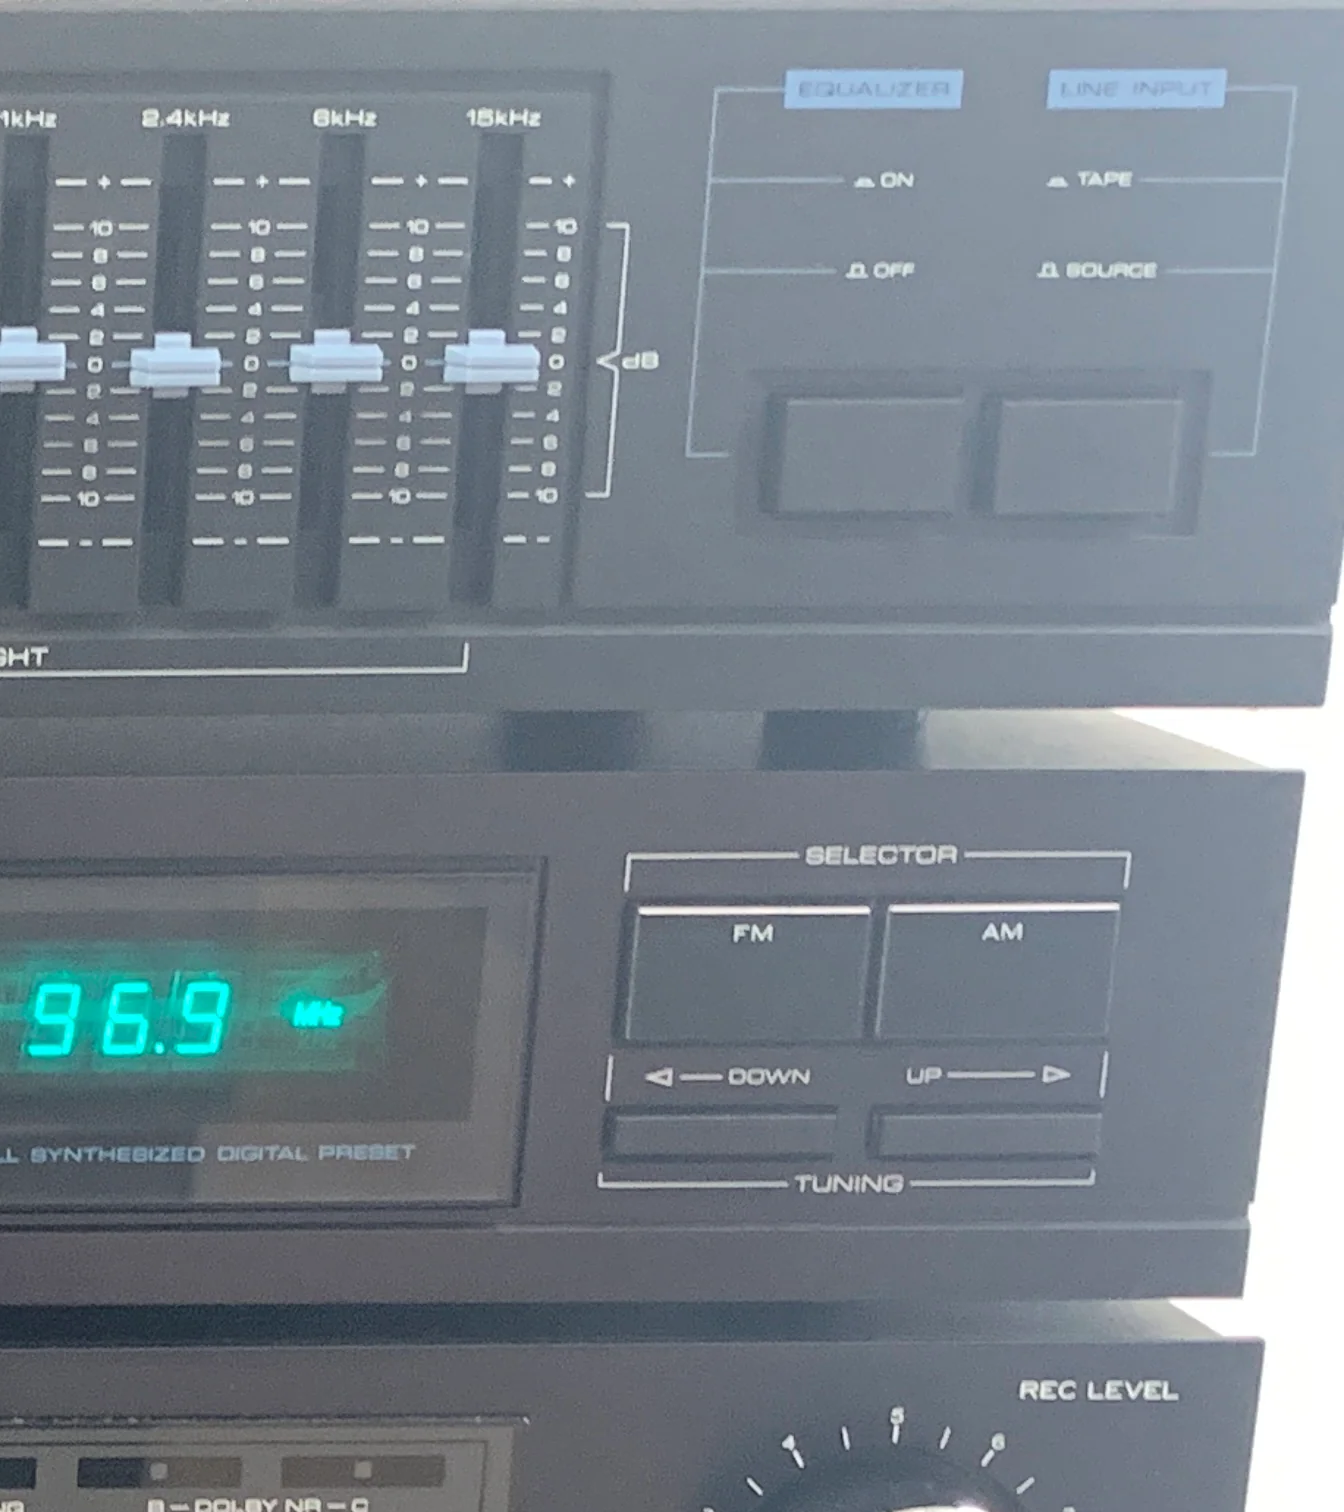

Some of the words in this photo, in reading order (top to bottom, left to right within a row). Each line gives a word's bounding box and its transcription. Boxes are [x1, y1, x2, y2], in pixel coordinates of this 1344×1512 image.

[799, 80, 950, 98] EQUALIZER
[1061, 80, 1119, 98] LINE
[1132, 81, 1212, 97] INPUT
[0, 110, 56, 128] 1kHz
[142, 109, 230, 127] 2.4kHz
[314, 109, 377, 127] 6kHz
[467, 108, 541, 127] 15kHz
[881, 172, 914, 188] ON
[1078, 171, 1132, 187] TAPE
[873, 262, 914, 279] OFF
[1067, 262, 1157, 278] SOURCE
[806, 845, 957, 865] SELECTOR
[734, 924, 773, 942] FM
[982, 923, 1023, 940] AM
[25, 980, 232, 1059] 96.9
[293, 1000, 347, 1029] MHz
[728, 1068, 810, 1085] DOWN
[907, 1067, 942, 1084] UP
[31, 1146, 206, 1163] SYNTHESIZED
[217, 1144, 308, 1166] DIGITAL
[319, 1144, 415, 1164] PRESET
[795, 1174, 904, 1192] TUNING
[1020, 1380, 1076, 1400] REC
[1088, 1380, 1178, 1400] LEVEL
